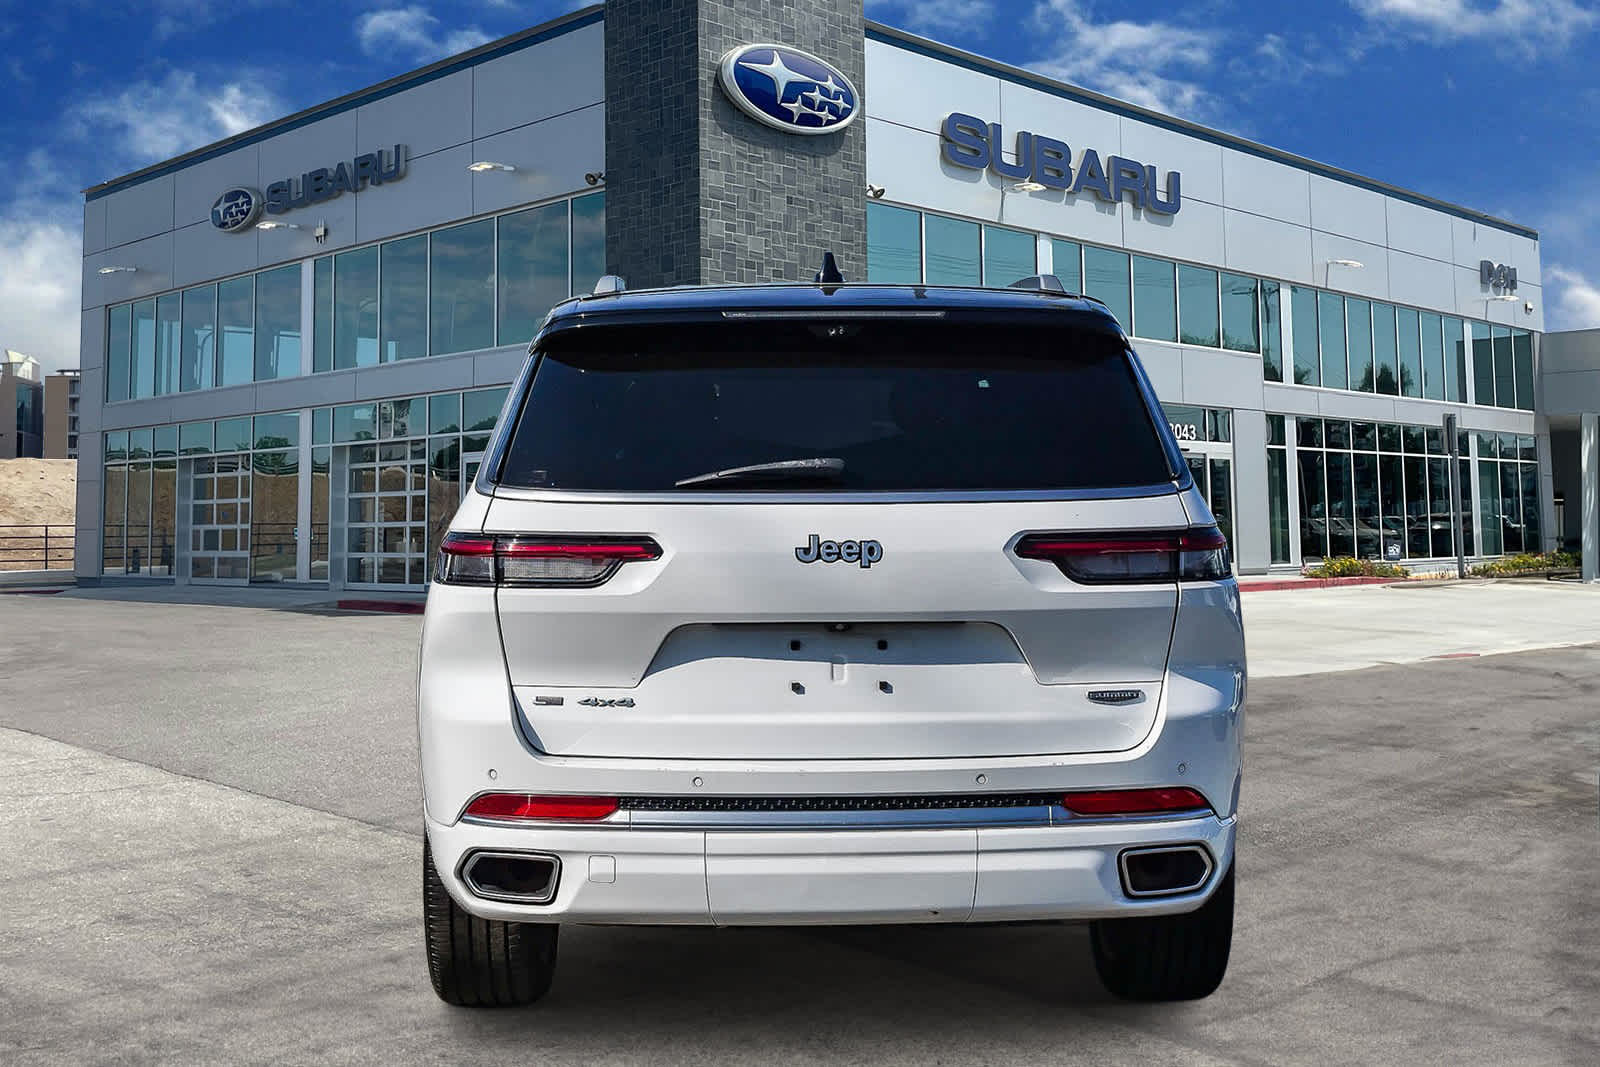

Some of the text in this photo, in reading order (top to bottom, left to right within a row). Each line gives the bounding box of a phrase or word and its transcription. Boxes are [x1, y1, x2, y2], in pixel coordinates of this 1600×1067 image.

[265, 144, 407, 214] SUBARU
[941, 112, 1181, 215] SUBARU
[795, 534, 882, 568] Jeep
[577, 697, 636, 707] 4x4
